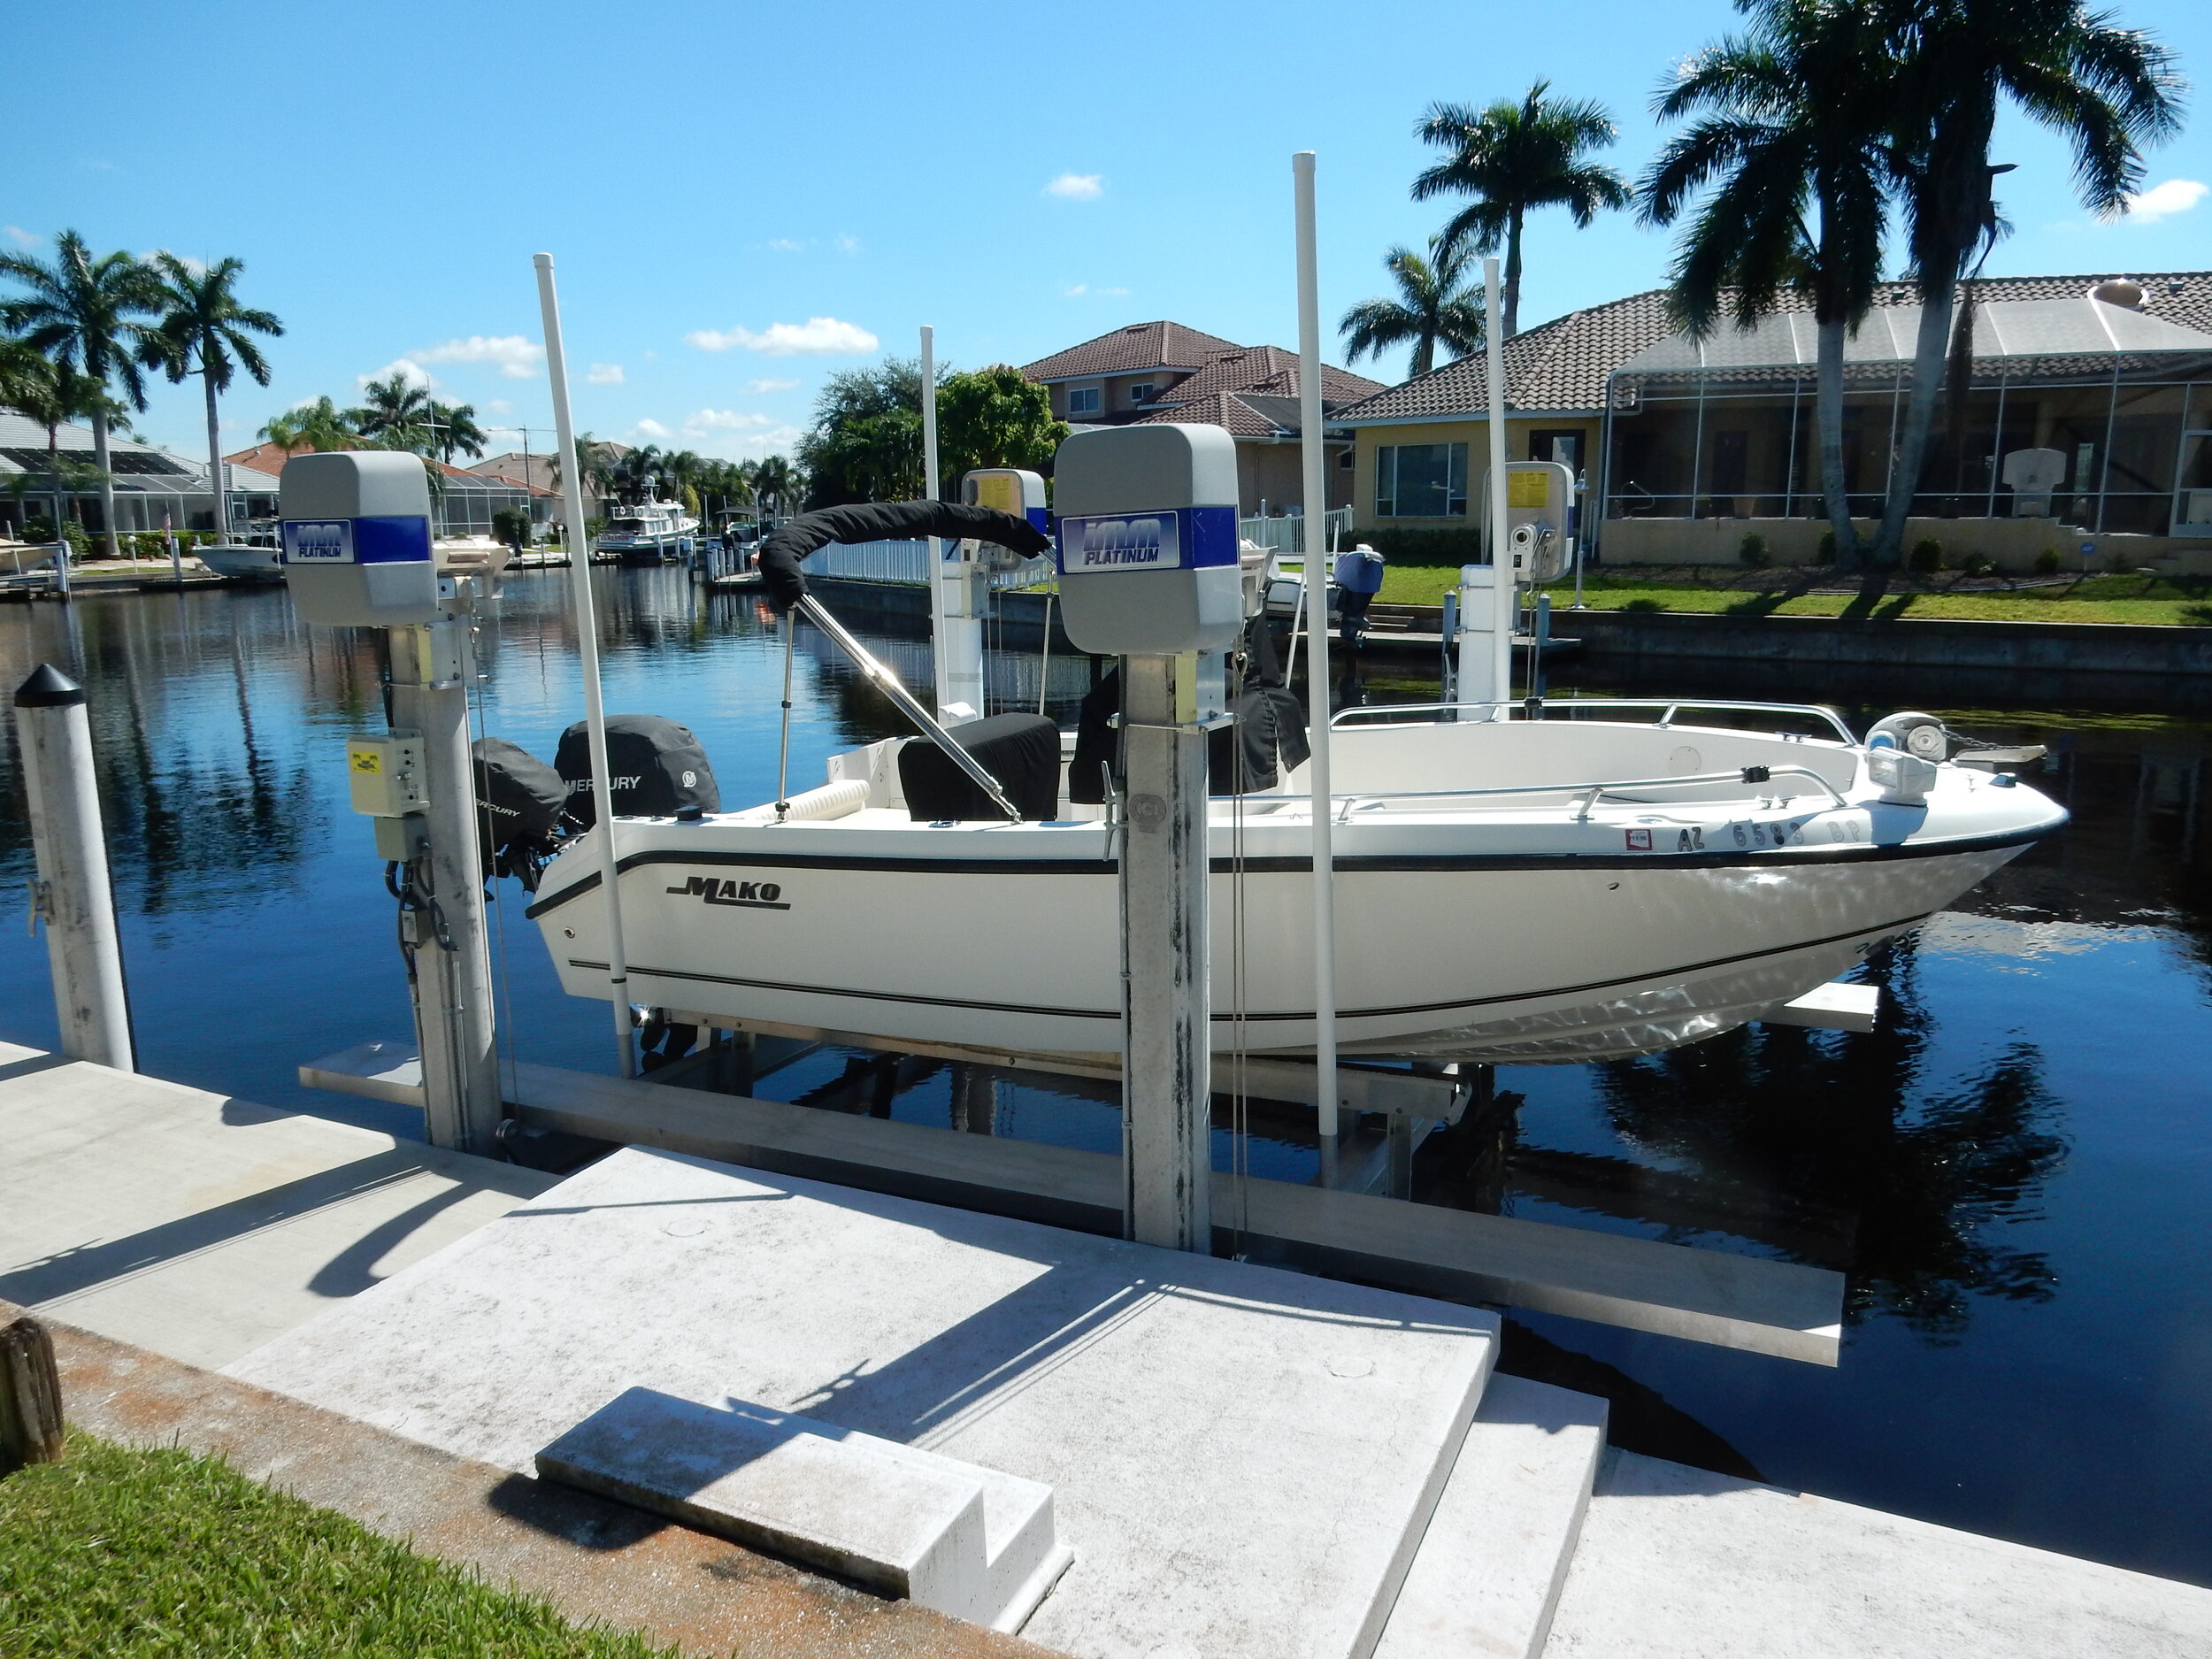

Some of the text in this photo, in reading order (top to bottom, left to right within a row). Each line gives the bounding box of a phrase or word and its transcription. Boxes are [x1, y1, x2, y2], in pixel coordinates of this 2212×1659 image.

[299, 547, 342, 557] PLATINUM
[1083, 549, 1159, 565] PLATINUM
[565, 776, 641, 795] MERURY
[476, 798, 521, 817] ERCURY
[1678, 826, 1704, 851] AZ
[666, 876, 791, 910] MAKO
